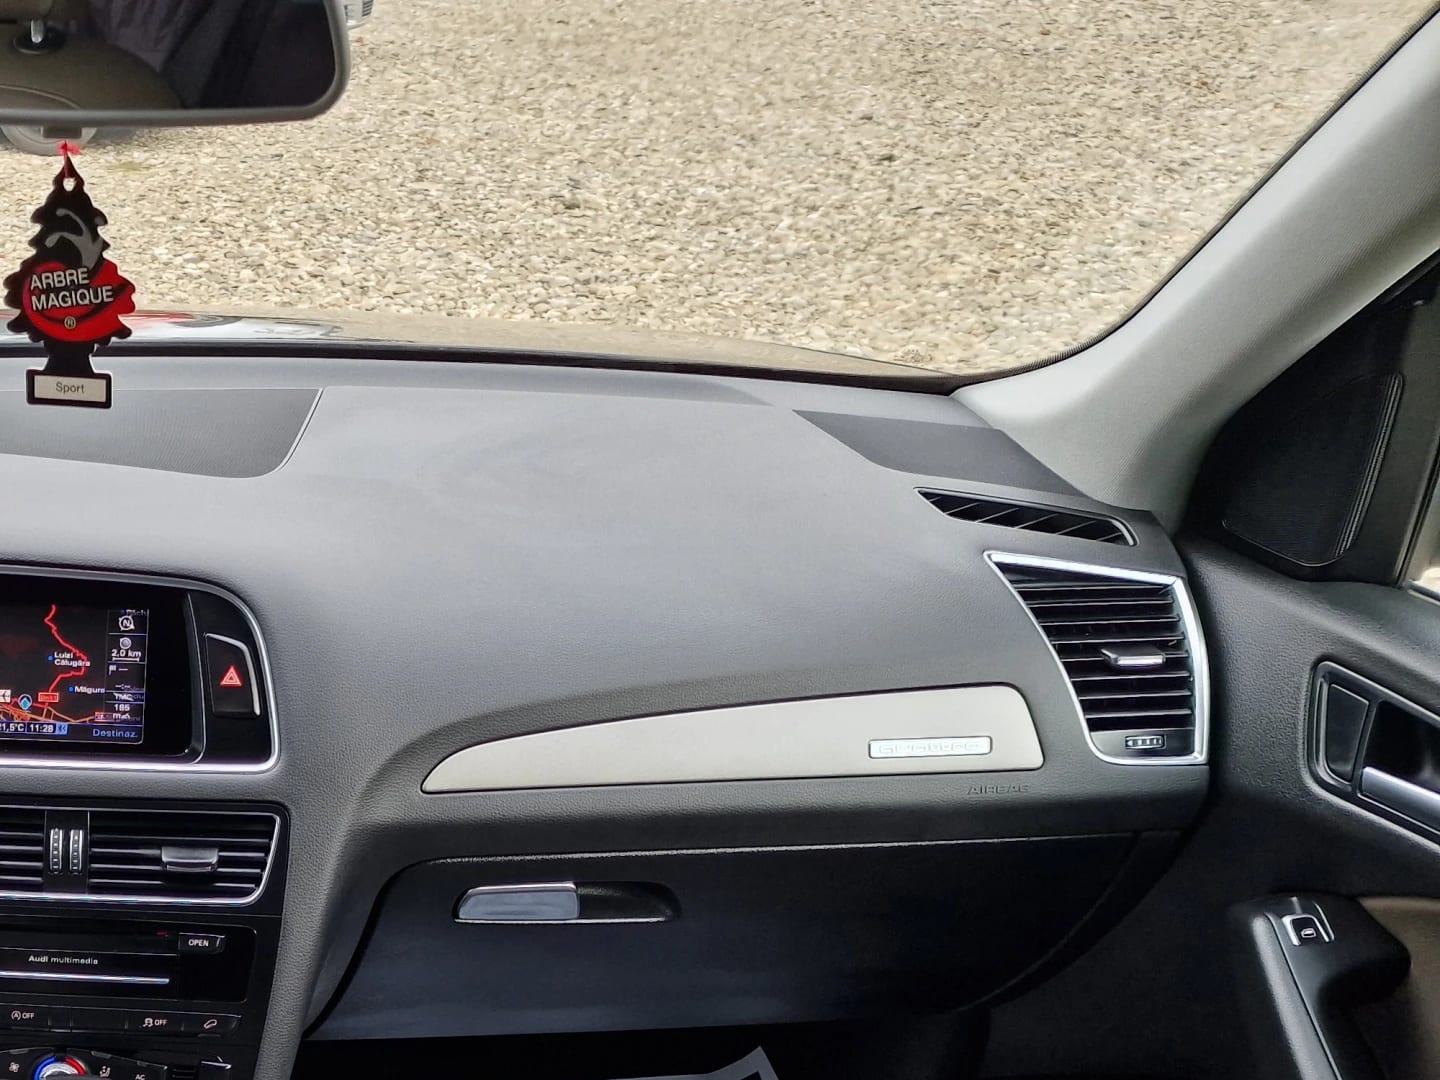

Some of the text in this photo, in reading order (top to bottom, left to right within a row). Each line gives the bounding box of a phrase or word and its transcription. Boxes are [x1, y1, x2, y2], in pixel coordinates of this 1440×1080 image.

[30, 267, 89, 290] ARBRE
[31, 286, 114, 311] MAGIQUE
[55, 381, 85, 394] Sport
[128, 649, 142, 657] km
[29, 724, 55, 734] 11:28
[92, 728, 138, 738] Destinaz.
[188, 939, 209, 947] OPEN
[28, 954, 99, 965] Audi multimedia
